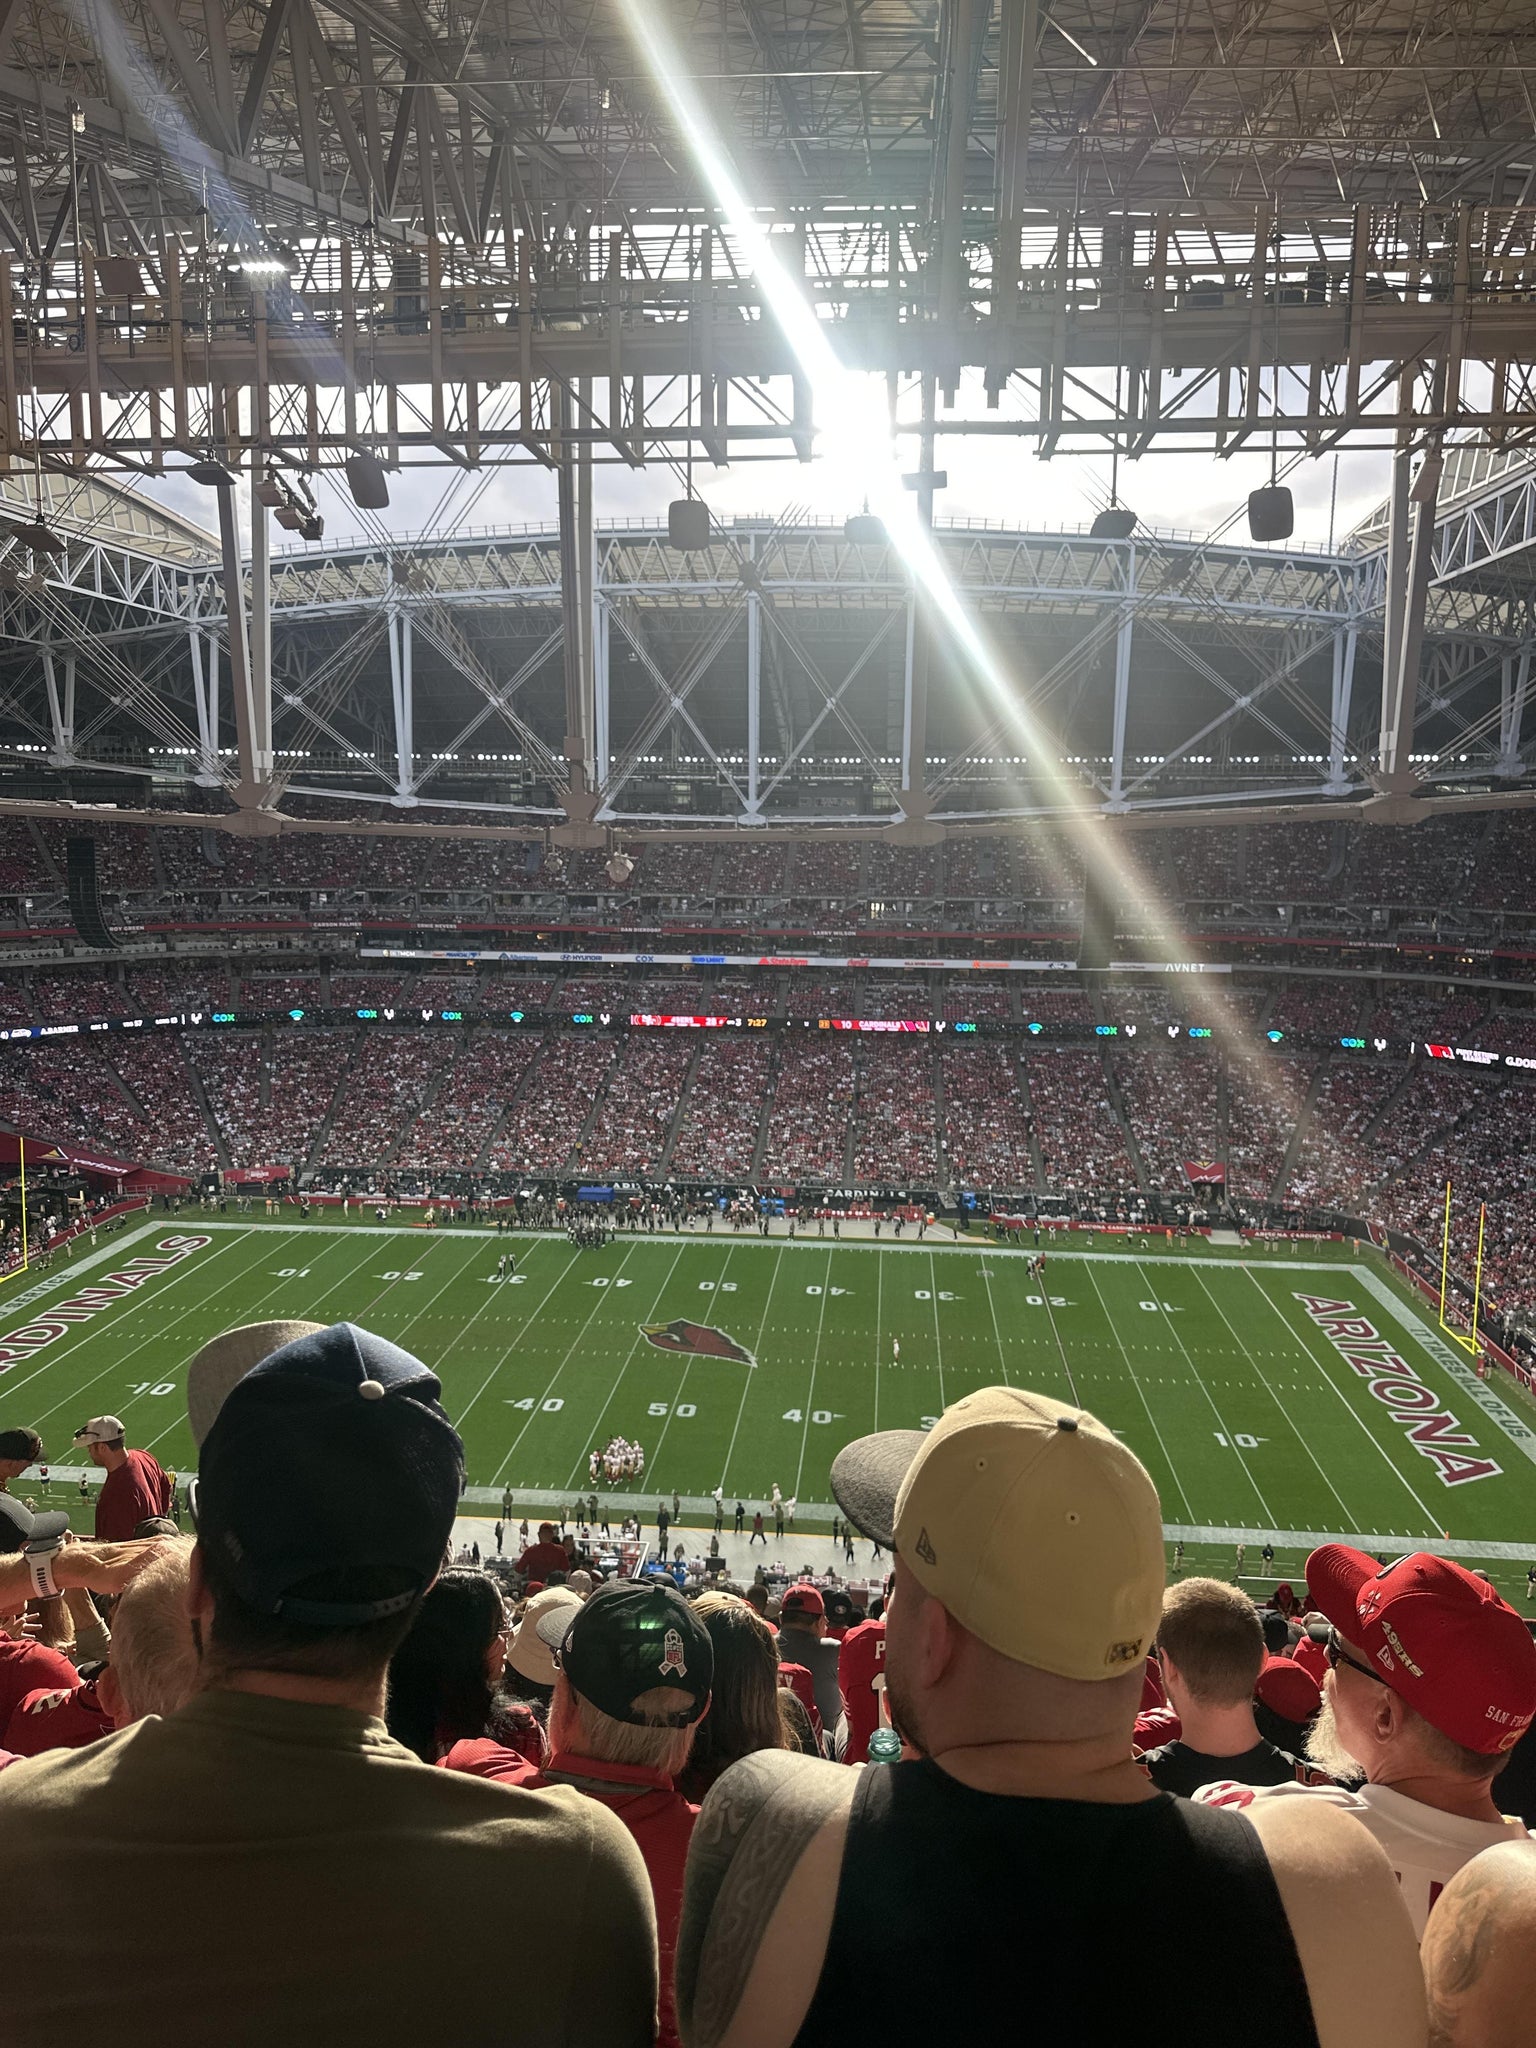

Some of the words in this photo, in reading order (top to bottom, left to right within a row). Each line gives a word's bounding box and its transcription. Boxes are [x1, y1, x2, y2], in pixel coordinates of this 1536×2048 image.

[635, 955, 654, 963] COX
[1165, 963, 1205, 973] AVNET
[212, 1014, 236, 1023] COX
[357, 1010, 378, 1019] COX
[441, 1011, 462, 1020] COX
[572, 1014, 594, 1023] COX
[747, 1018, 767, 1027] 7:27
[841, 1020, 852, 1029] 10
[859, 1020, 901, 1029] CARDINALS
[955, 1022, 977, 1032] COX
[1095, 1026, 1118, 1036] COX
[1188, 1028, 1212, 1038] COX
[1341, 1037, 1366, 1048] COX
[73, 1158, 129, 1174] verizon
[4, 1274, 74, 1308] SERVICE
[698, 1281, 738, 1292] 50
[132, 1382, 177, 1396] 10
[1291, 1291, 1505, 1488] ARIZONA
[1422, 1340, 1468, 1374] TAKES
[1455, 1375, 1490, 1397] ALL
[1481, 1400, 1511, 1417] OF
[1499, 1419, 1531, 1438] US
[513, 1398, 565, 1412] 40
[647, 1402, 698, 1418] 50
[782, 1408, 832, 1424] 40
[1213, 1432, 1259, 1448] 10
[1381, 1620, 1424, 1679] 49ERS
[1484, 1705, 1511, 1724] SAN
